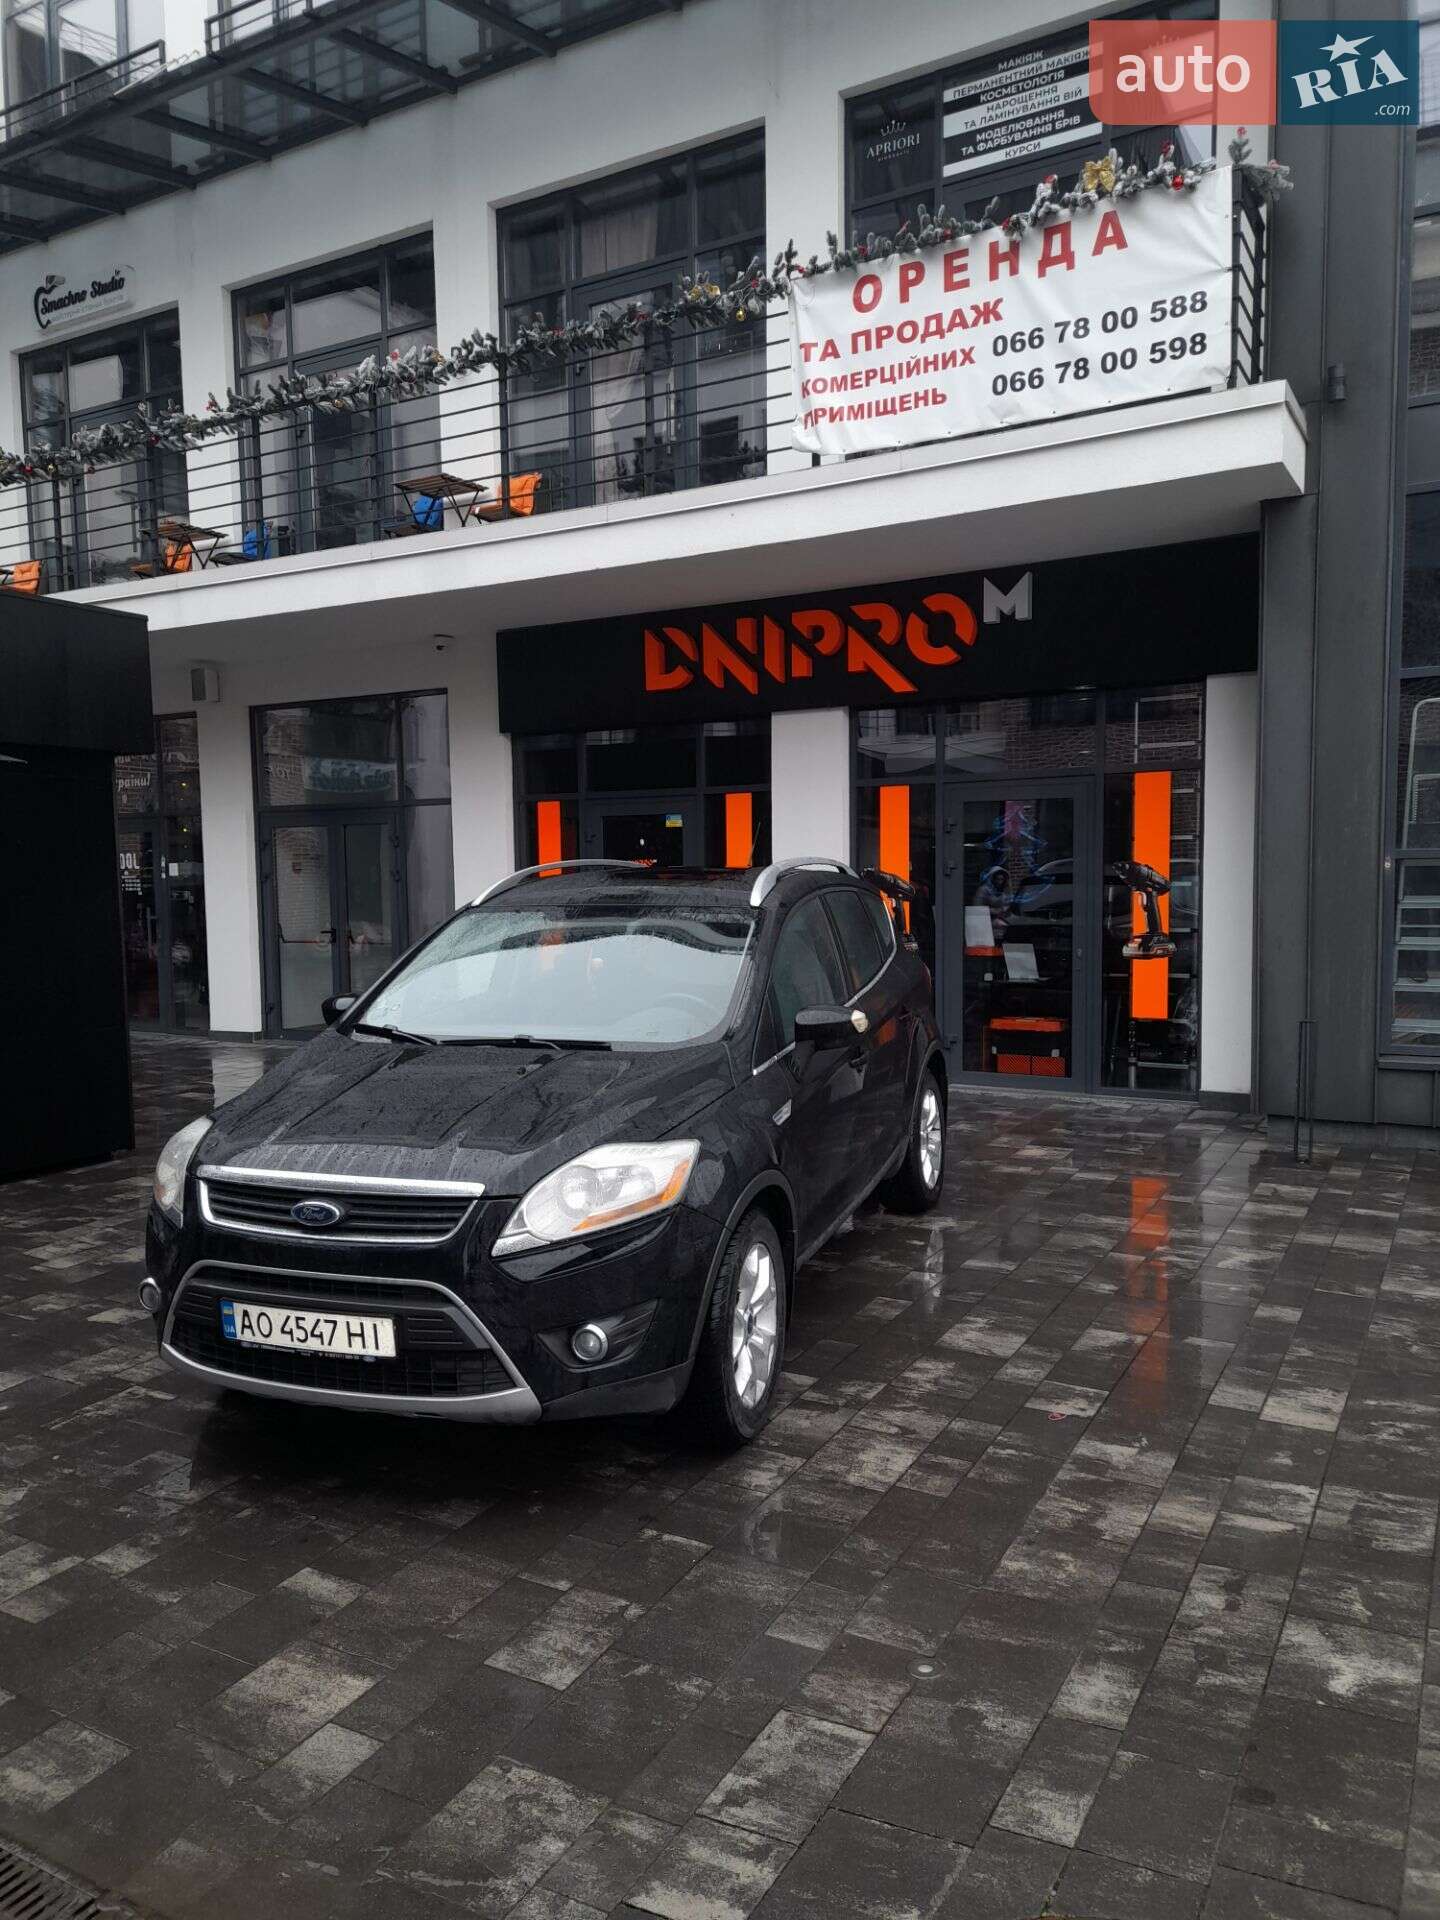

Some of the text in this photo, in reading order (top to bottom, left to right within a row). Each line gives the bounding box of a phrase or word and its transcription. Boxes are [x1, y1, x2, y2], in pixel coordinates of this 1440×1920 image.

[953, 63, 1044, 99] ПЕРМАНЕНТНИЙ
[998, 50, 1044, 72] МАКІЯЖ
[980, 70, 1065, 103] КОСМЕТОЛОГІЯ
[987, 85, 1058, 114] НАРОЩЕННЯ
[964, 88, 1083, 131] ТА ЛАМІНУВАННЯ ВІЙ
[976, 109, 1065, 143] МОДЕЛЮВАННЯ
[867, 132, 920, 159] APRIORI
[961, 115, 1081, 156] ТА ФАРБУВАННЯ БРІВ
[1005, 141, 1041, 159] КУРСИ
[853, 210, 1128, 314] ОРЕНДА
[41, 289, 87, 316] Smachno
[90, 270, 126, 298] Studio
[799, 297, 1004, 363] ТА ПРОДАЖ
[992, 290, 1208, 357] 066 78 00 588
[801, 345, 976, 399] КОМЕРЦІЙНИХ
[992, 332, 1208, 396] 066 78 00 598
[803, 387, 948, 430] ПРИМІЩЕНЬ
[643, 571, 1033, 696] DNIPRO M
[224, 1309, 379, 1351] UA AO 4547 HI
